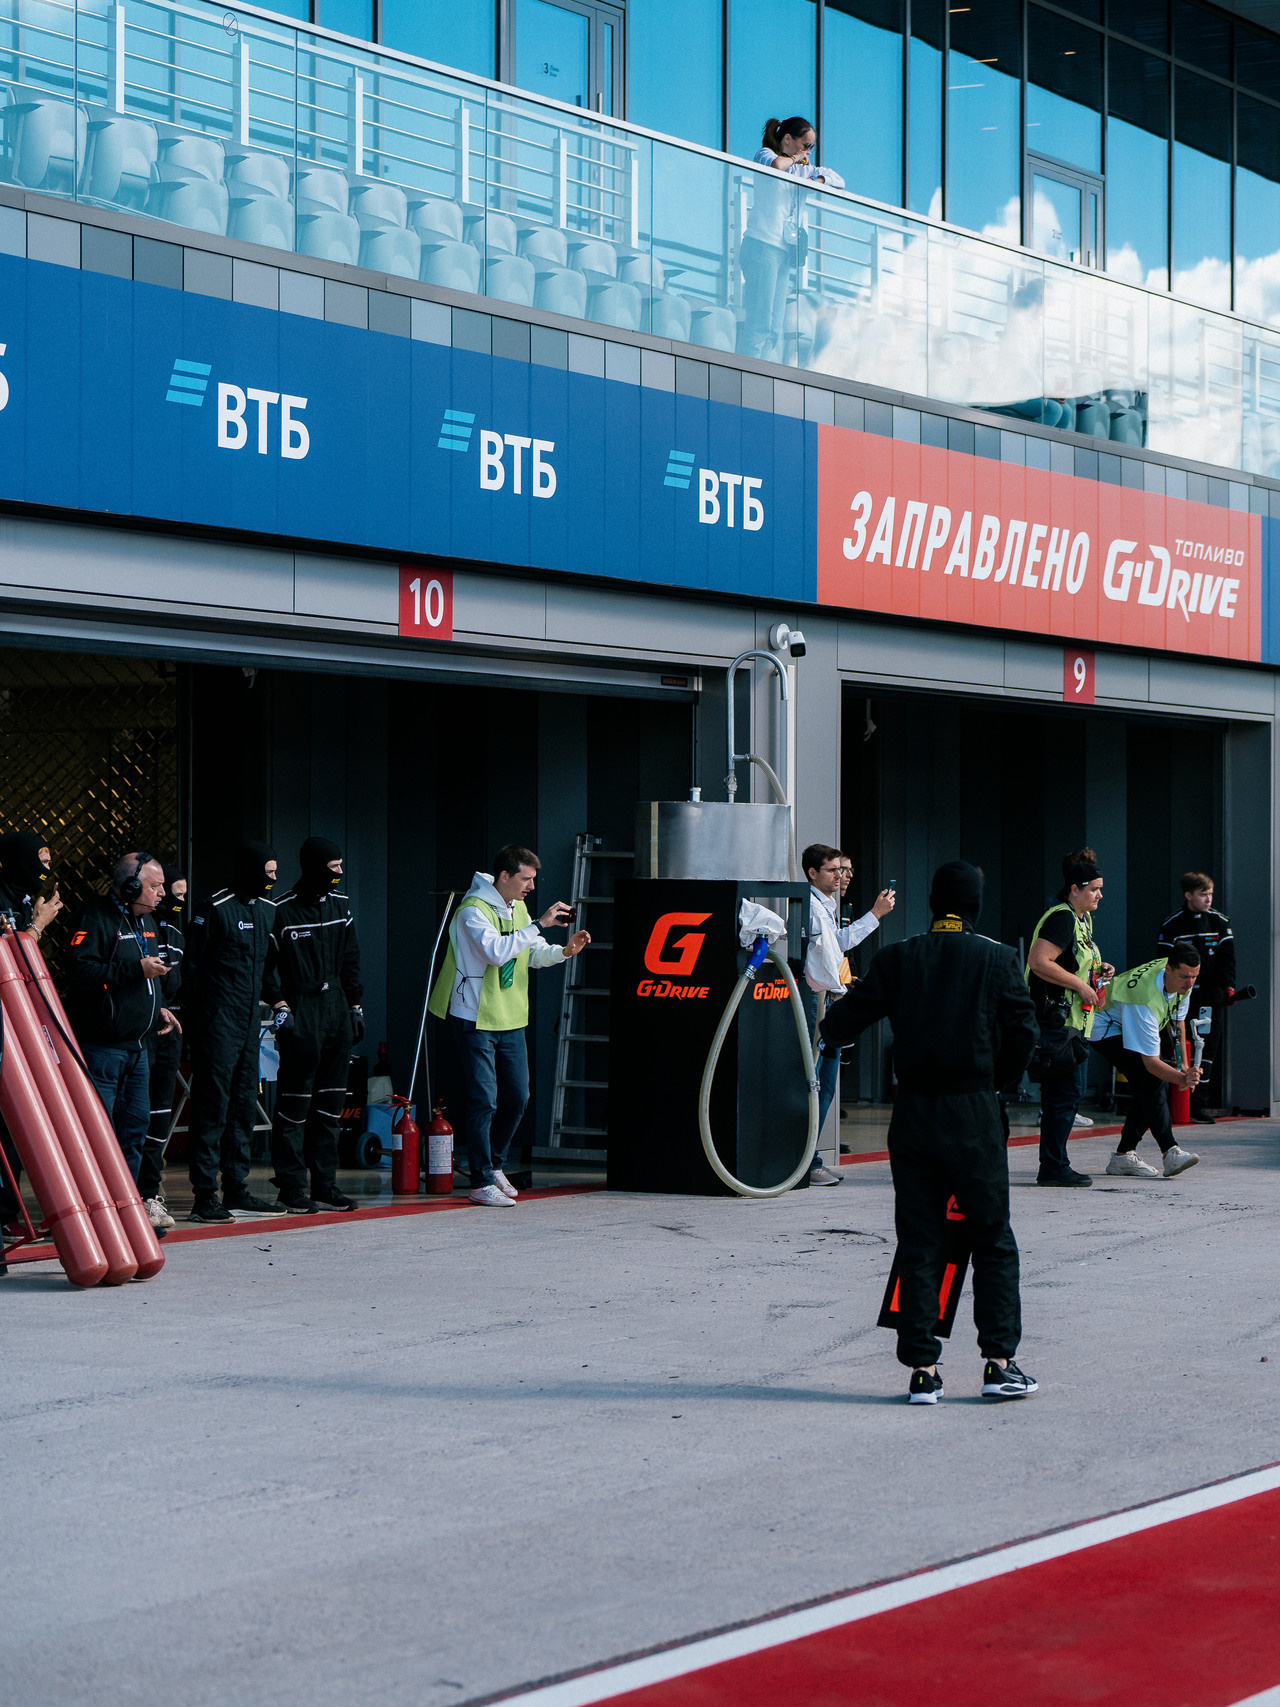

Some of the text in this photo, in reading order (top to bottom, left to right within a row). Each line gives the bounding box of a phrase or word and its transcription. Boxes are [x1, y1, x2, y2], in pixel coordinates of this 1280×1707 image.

[217, 383, 310, 460] ВТБ
[480, 429, 557, 499] ВТБ
[698, 468, 765, 532] ВТБ
[842, 490, 1091, 595] ЗАПРАВЛЕНО
[1175, 538, 1244, 568] ТОПЛИВО
[409, 577, 445, 628] 10
[1073, 657, 1086, 694] 9
[644, 912, 713, 976] G
